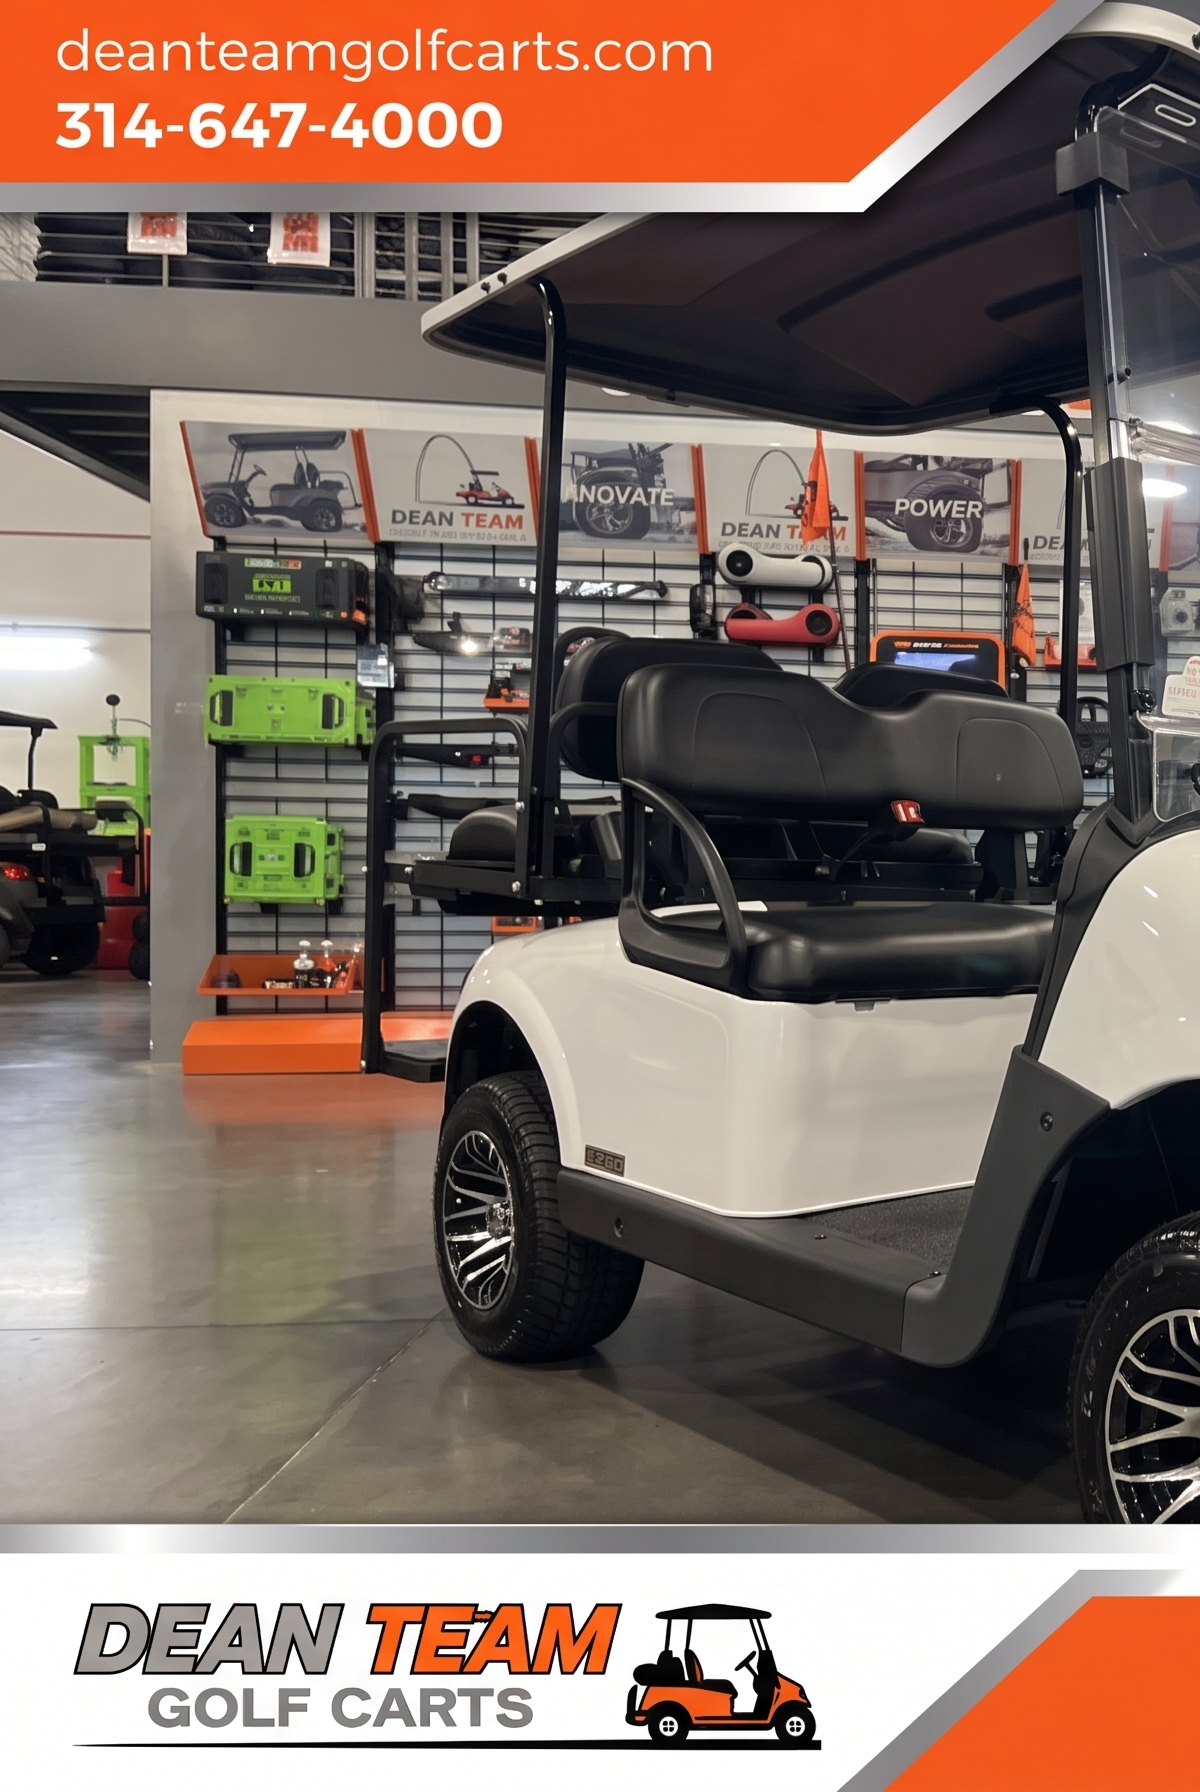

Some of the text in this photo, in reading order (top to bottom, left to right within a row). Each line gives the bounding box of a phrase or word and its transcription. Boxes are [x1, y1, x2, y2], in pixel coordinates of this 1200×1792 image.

[894, 498, 983, 518] POWER
[391, 509, 523, 530] DEAN TEAM
[721, 522, 846, 541] DEAN TM
